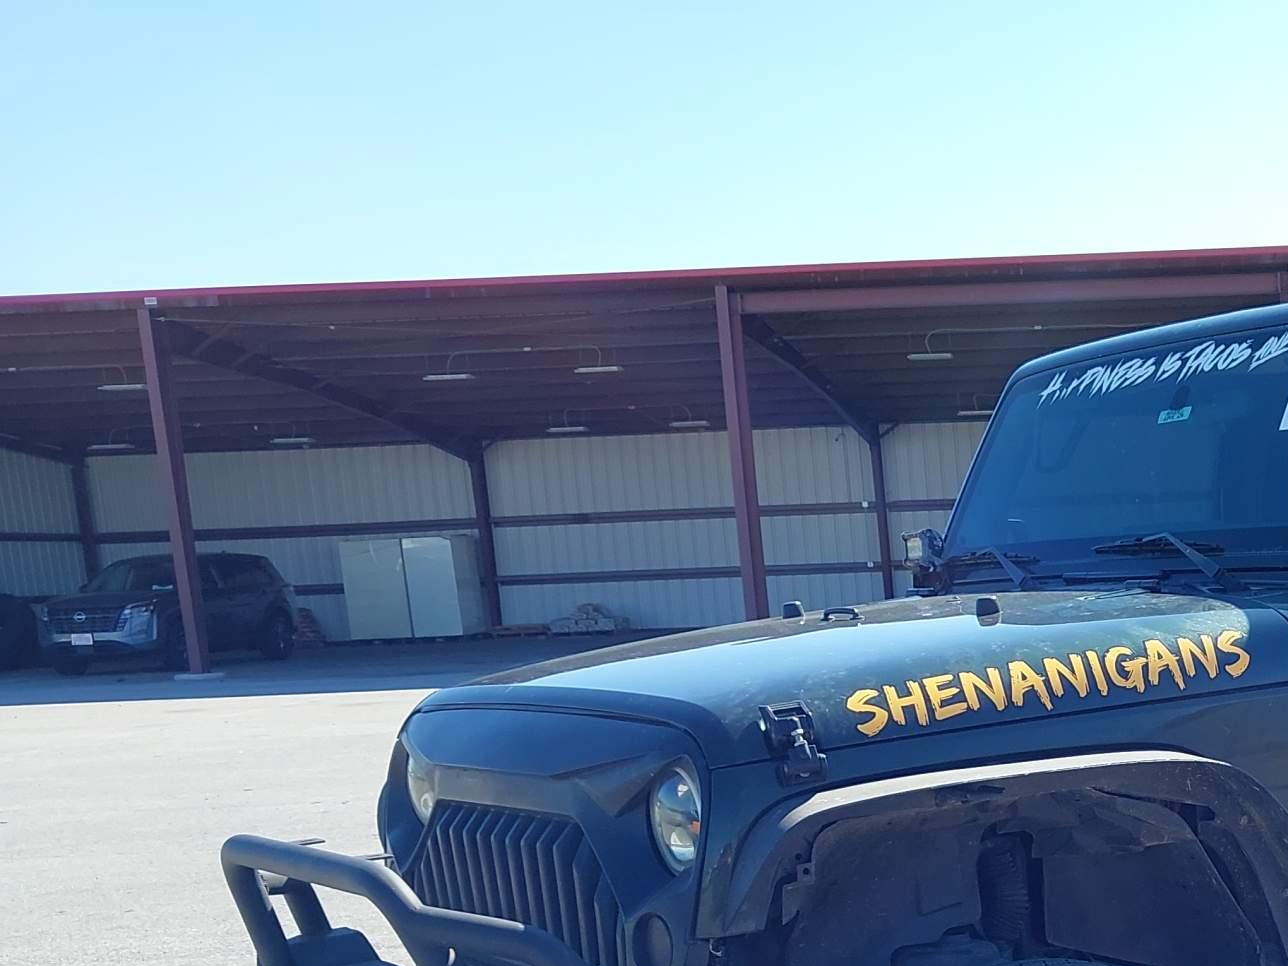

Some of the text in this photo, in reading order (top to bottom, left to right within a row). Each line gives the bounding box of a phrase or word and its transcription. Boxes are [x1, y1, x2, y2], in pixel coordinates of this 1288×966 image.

[1036, 356, 1159, 409] HPINESS
[1153, 351, 1185, 384] IS
[1176, 339, 1254, 384] TACOS
[846, 630, 1251, 737] SHENANIGANS
